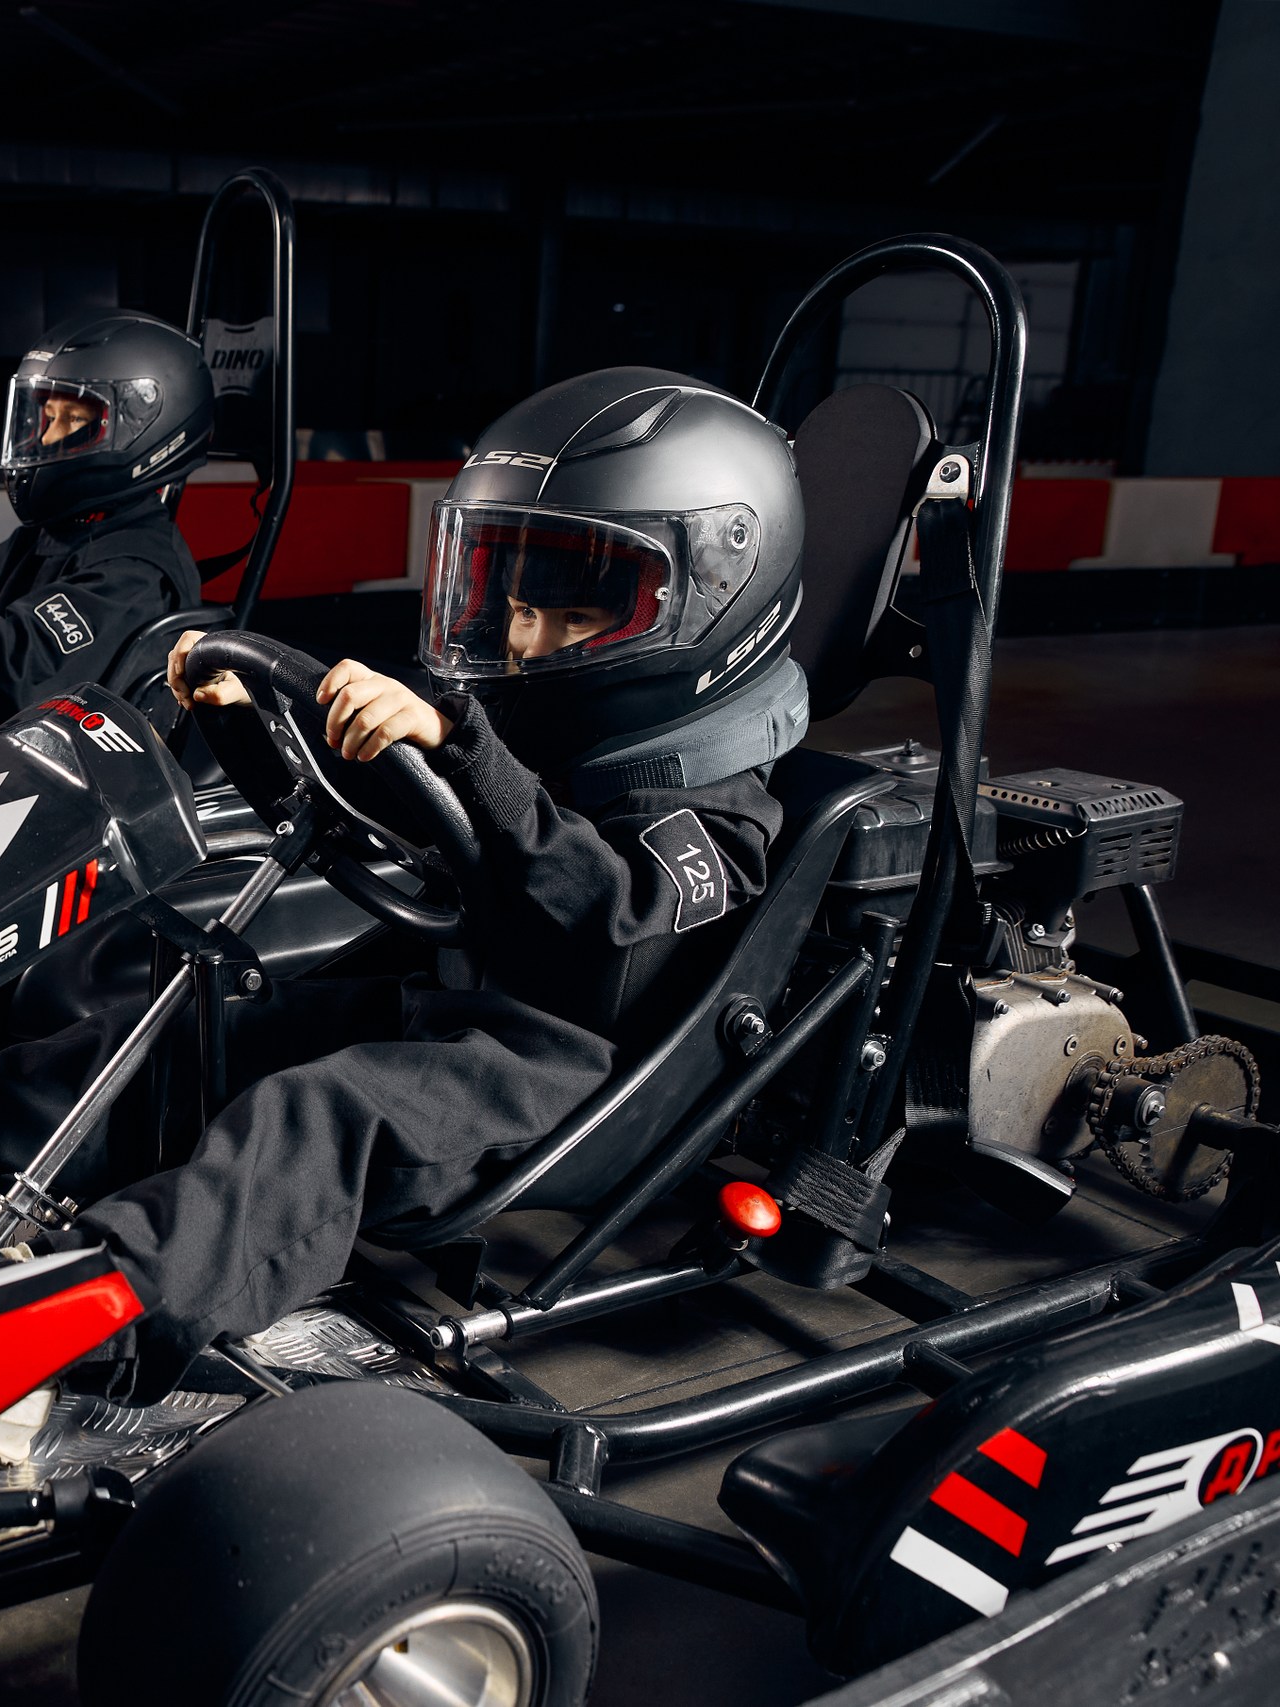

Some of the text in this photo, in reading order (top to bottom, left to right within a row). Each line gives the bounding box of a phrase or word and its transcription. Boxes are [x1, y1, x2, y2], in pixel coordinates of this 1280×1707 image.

[210, 349, 265, 370] DINO
[132, 431, 186, 479] LS2
[462, 450, 555, 471] LS2
[46, 603, 84, 645] 44-46
[695, 600, 781, 695] LS2
[676, 843, 715, 904] 125
